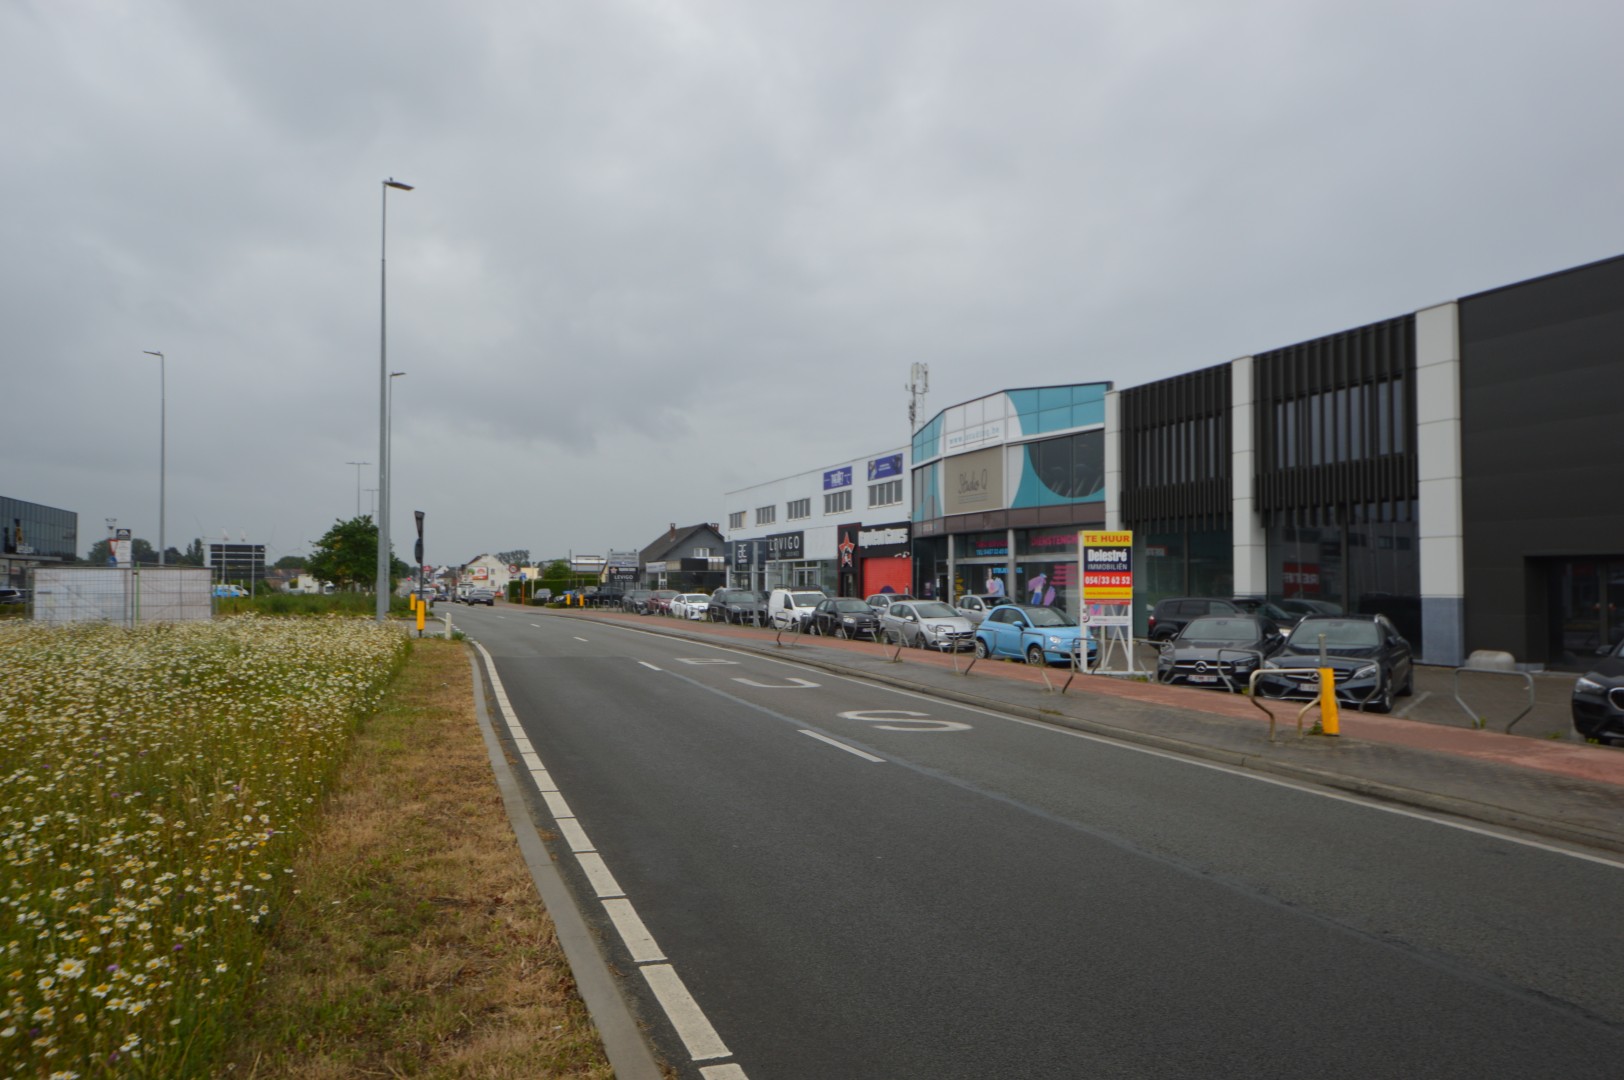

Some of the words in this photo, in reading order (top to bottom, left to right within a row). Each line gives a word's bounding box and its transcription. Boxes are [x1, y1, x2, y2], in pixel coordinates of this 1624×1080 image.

[769, 535, 800, 551] LEVIGO
[1085, 535, 1098, 543] TE
[1101, 535, 1130, 543] HUUR
[1087, 548, 1128, 562] Delestré
[1085, 575, 1110, 585] 054/33
[1111, 575, 1120, 585] 62
[1121, 575, 1131, 585] 52
